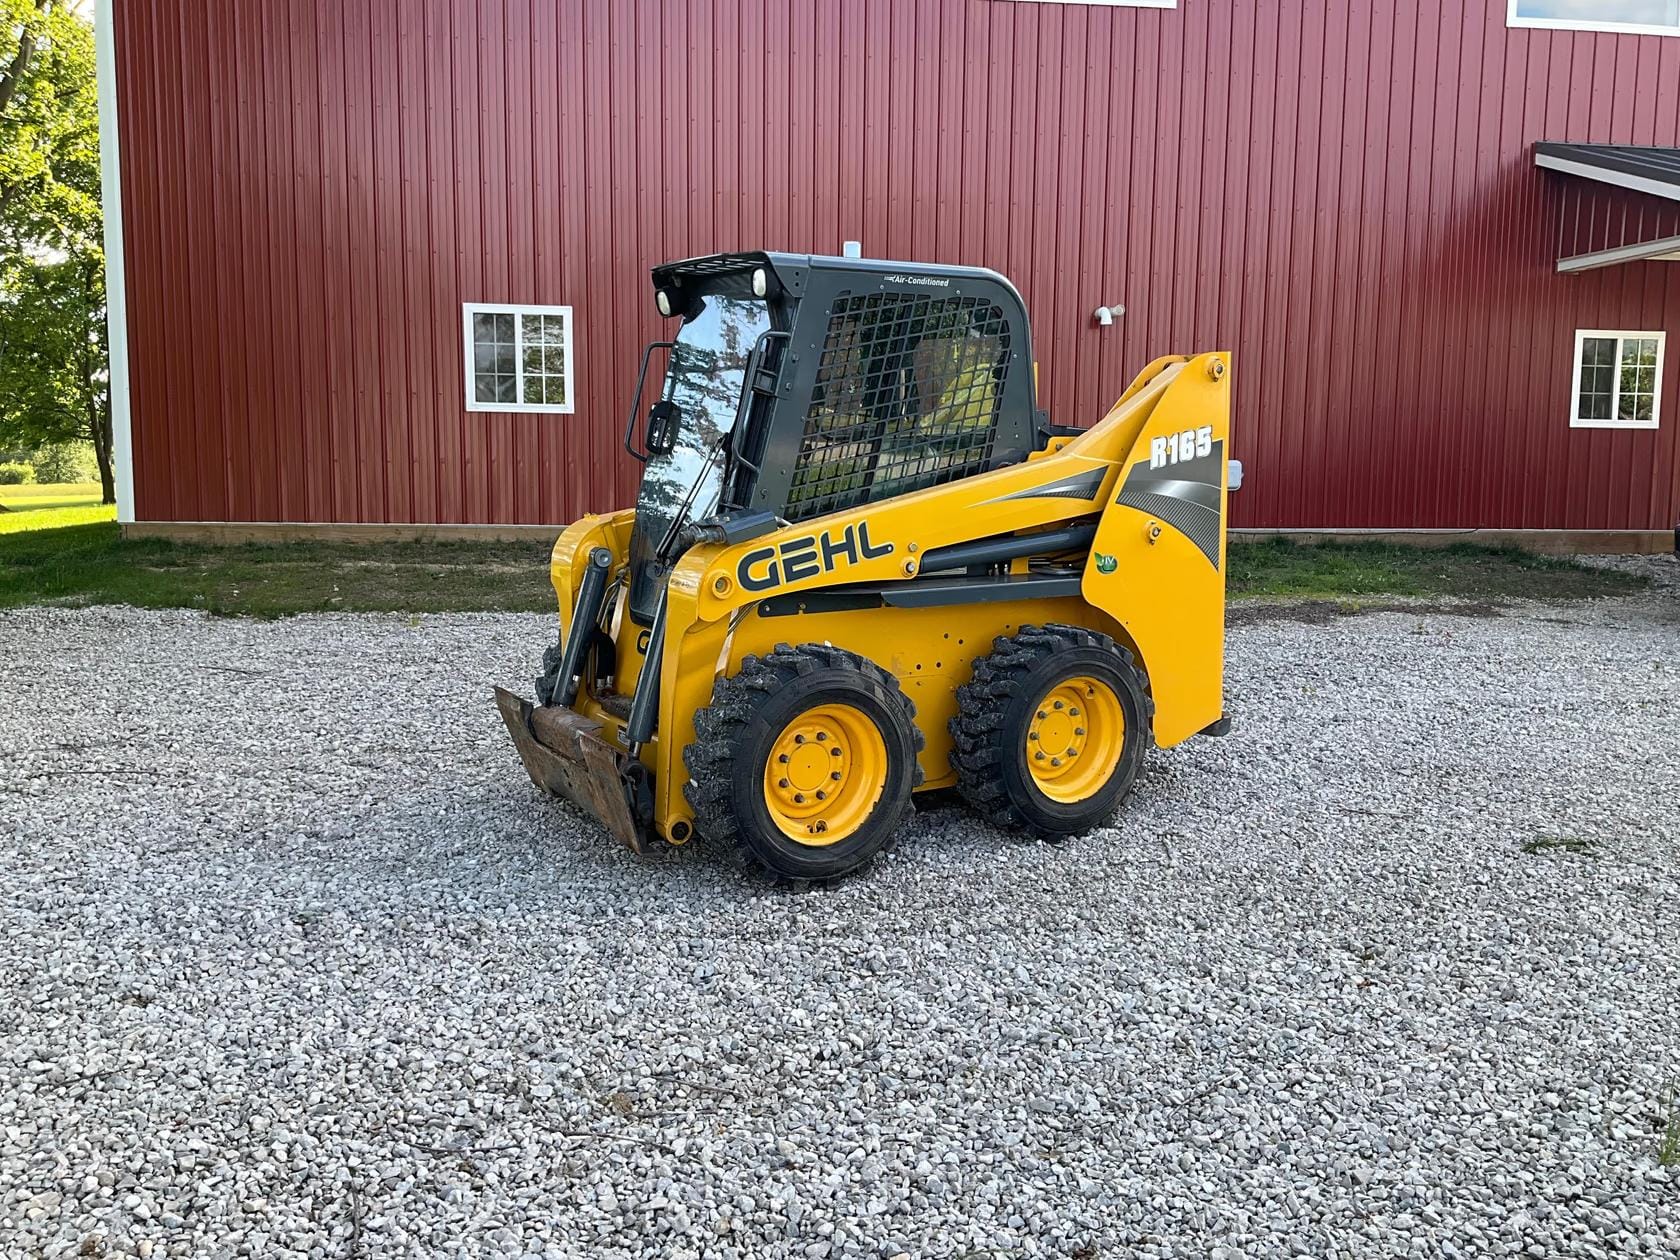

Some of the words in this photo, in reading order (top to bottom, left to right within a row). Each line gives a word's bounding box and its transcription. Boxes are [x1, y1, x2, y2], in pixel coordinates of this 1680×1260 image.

[894, 275, 950, 287] Air-Conditioned
[1149, 424, 1213, 470] R165
[737, 520, 895, 592] GEHL
